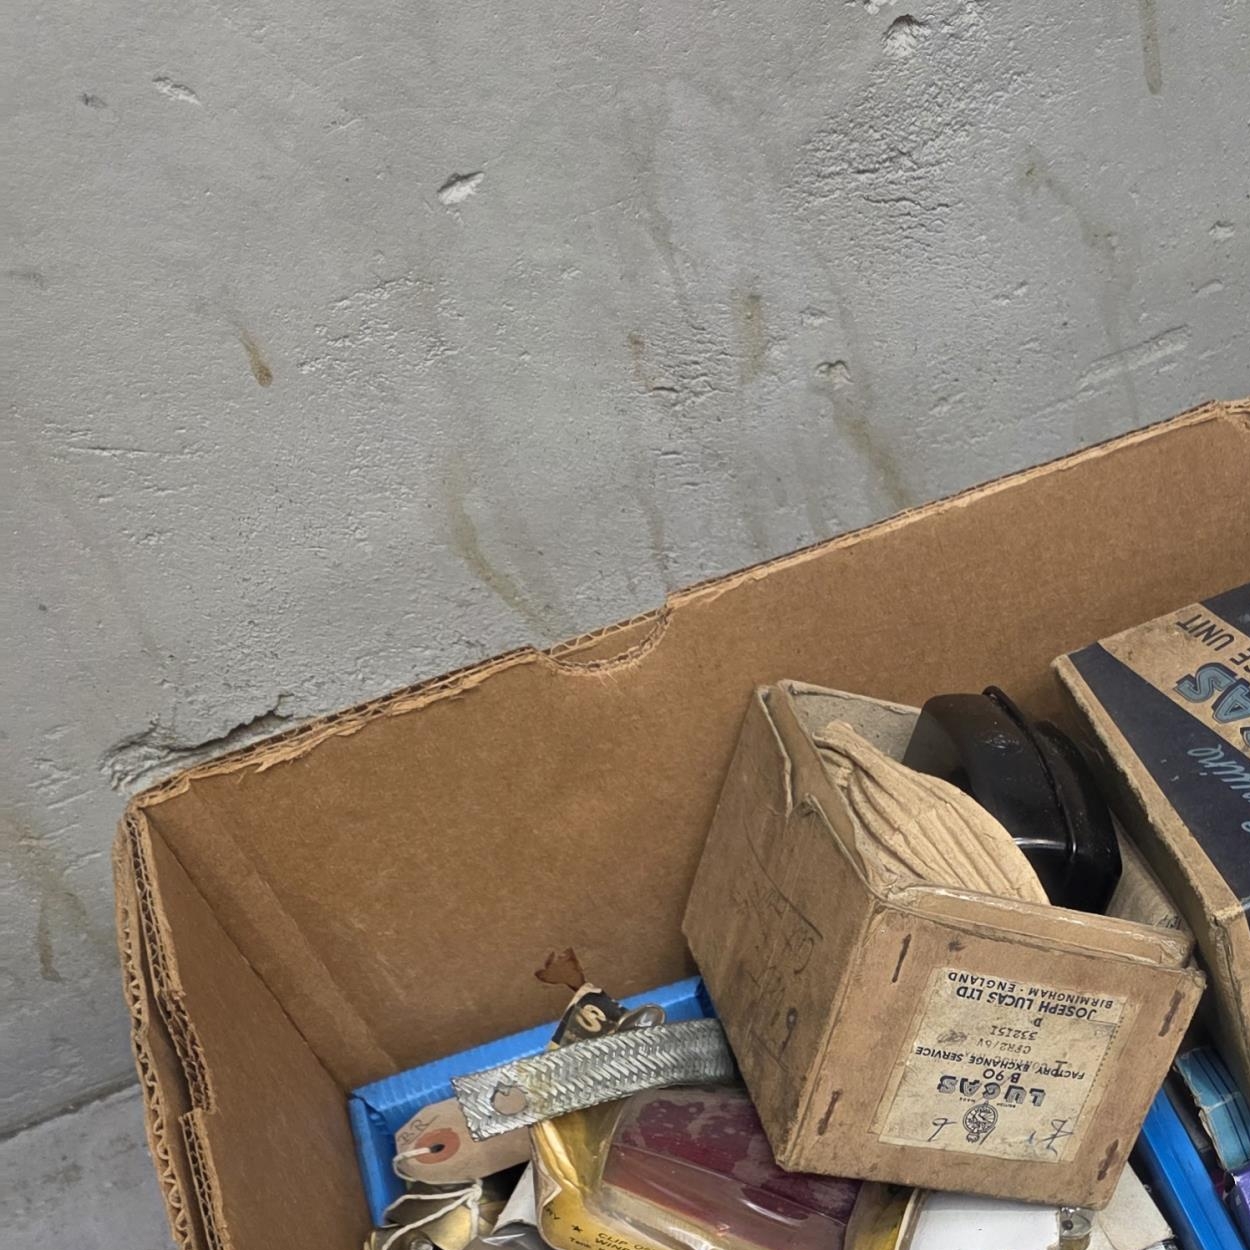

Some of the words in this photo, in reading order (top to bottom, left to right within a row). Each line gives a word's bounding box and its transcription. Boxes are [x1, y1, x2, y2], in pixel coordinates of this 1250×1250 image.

[1177, 614, 1235, 651] UNIT
[948, 971, 1016, 993] ENGLAND
[956, 986, 983, 1001] LTD
[988, 992, 1034, 1010] LUCAS
[1028, 987, 1114, 1009] BIRMINGHAM
[1038, 1003, 1098, 1021] JOSEPH
[915, 1046, 964, 1063] SERVICE
[968, 1055, 1030, 1072] EXCHANGE
[1034, 1066, 1085, 1080] FACTORY
[937, 1075, 1046, 1107] LUCAS
